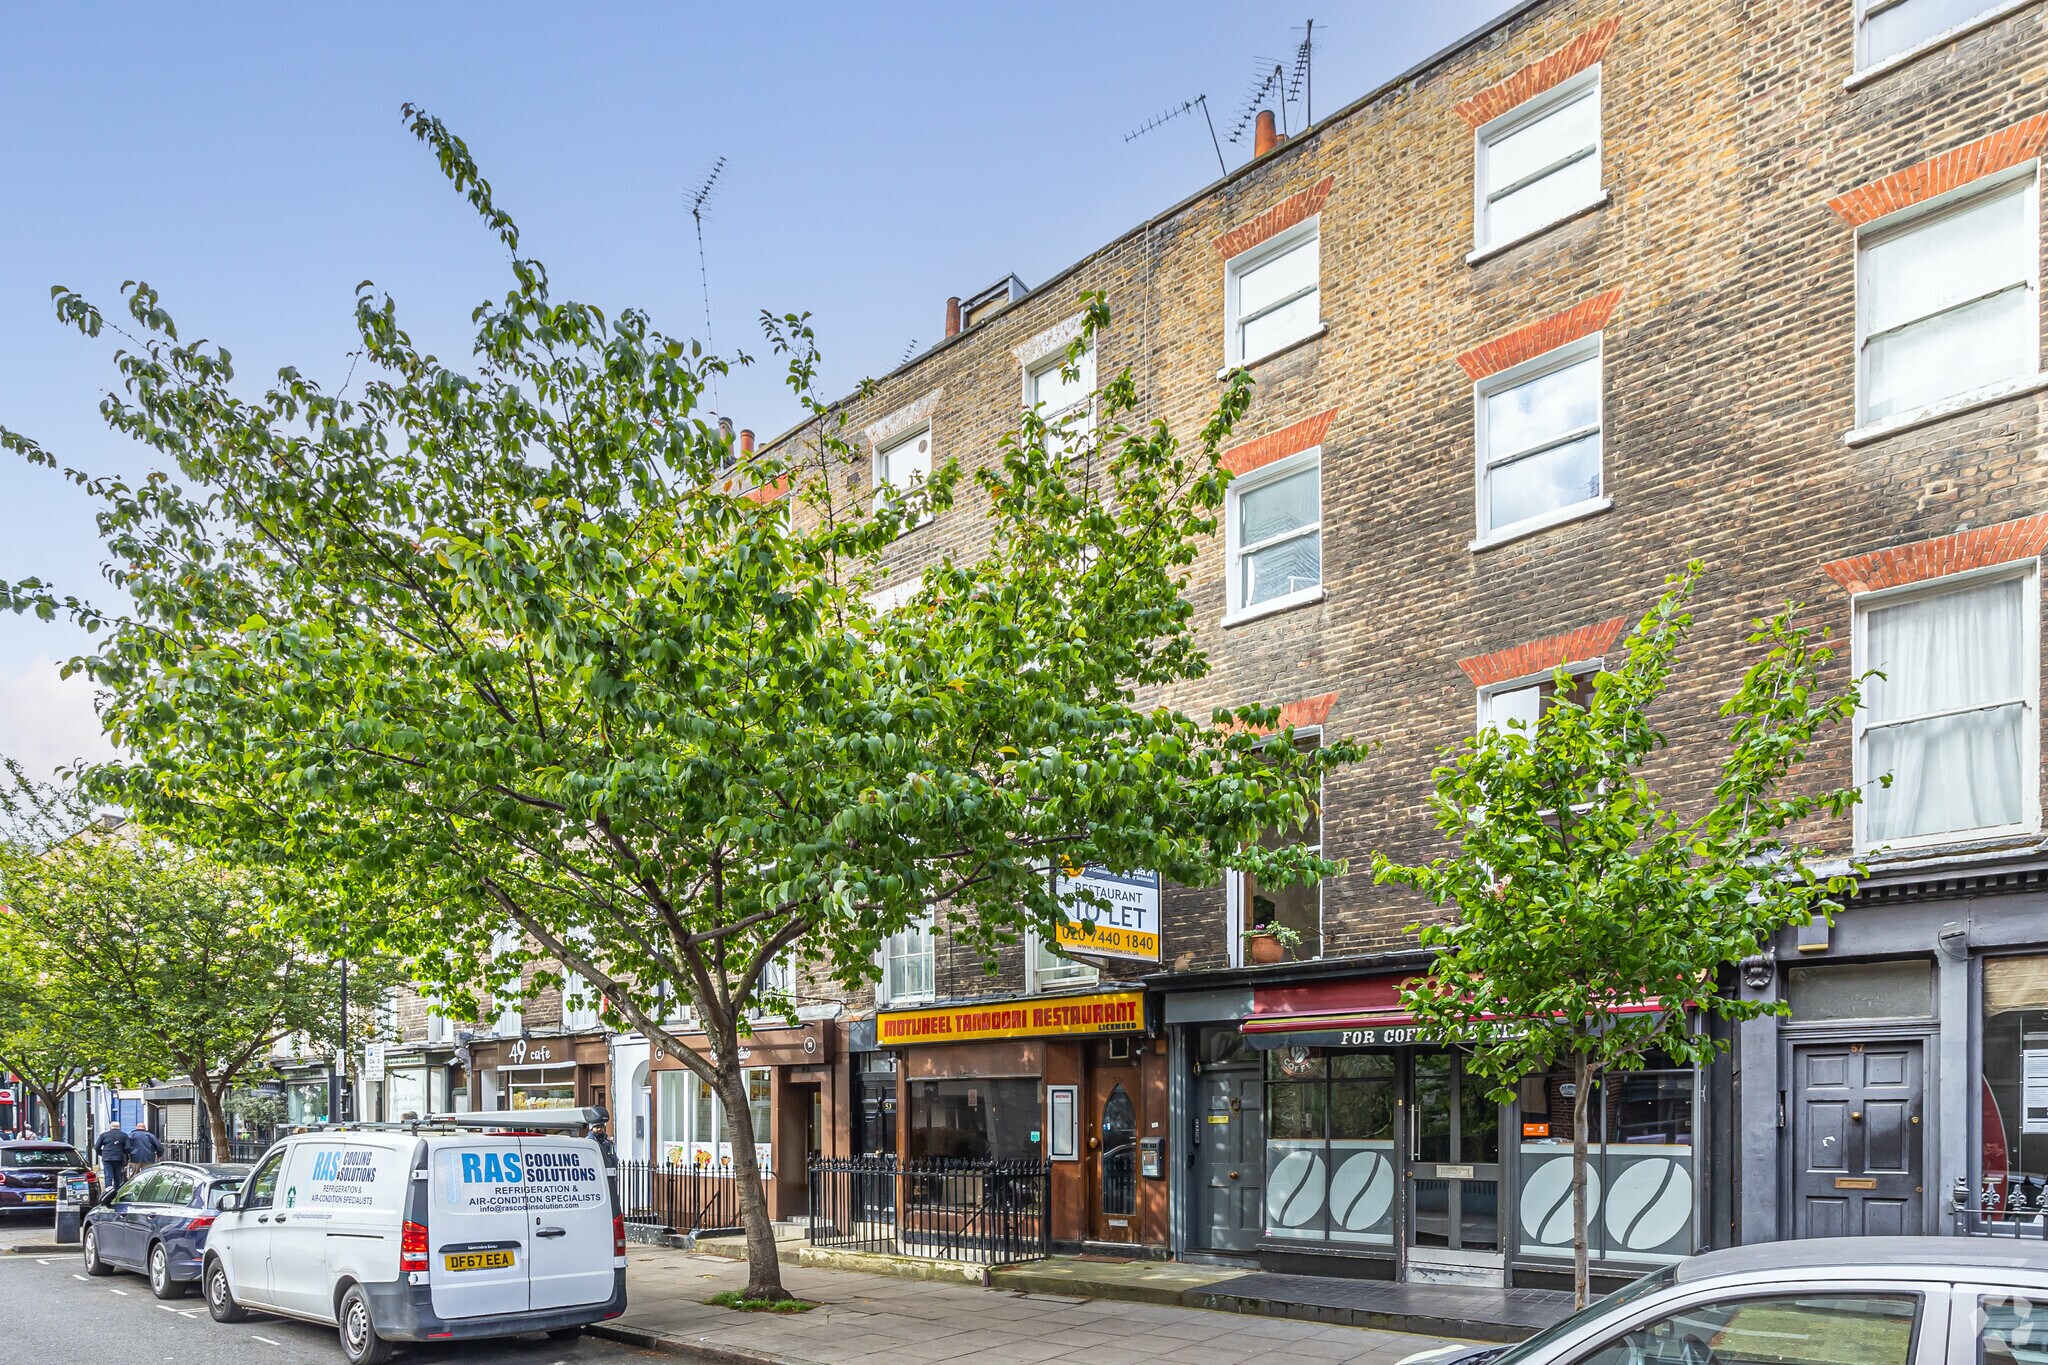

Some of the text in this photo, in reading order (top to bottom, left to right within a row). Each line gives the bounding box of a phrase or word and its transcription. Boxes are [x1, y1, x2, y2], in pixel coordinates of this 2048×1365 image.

[1074, 898, 1146, 929] TO LET
[1125, 933, 1154, 950] 1840
[1077, 943, 1140, 956] www.jenkinslaw.co.uk
[955, 1009, 1027, 1032] TANDOORI
[1033, 1001, 1136, 1027] RESTAURANT
[1098, 1021, 1137, 1031] LICENSED
[1341, 1030, 1376, 1045] FOR
[509, 1039, 551, 1064] 49 cafe
[1850, 1043, 1864, 1053] 57
[1284, 1056, 1317, 1072] COFFEE
[312, 1151, 372, 1181] RAS COOLING
[461, 1152, 580, 1183] RAS COOLING
[340, 1167, 376, 1182] SOLUTIONS
[527, 1168, 596, 1183] SOLUTIONS
[323, 1185, 357, 1193] REFRIGERATION
[495, 1186, 569, 1195] REFRIGERATION
[343, 1196, 373, 1205] SPECIALISTS
[469, 1193, 601, 1206] AIR-CONDITION SPECIALISTS
[450, 1253, 509, 1268] DF67 EEA
